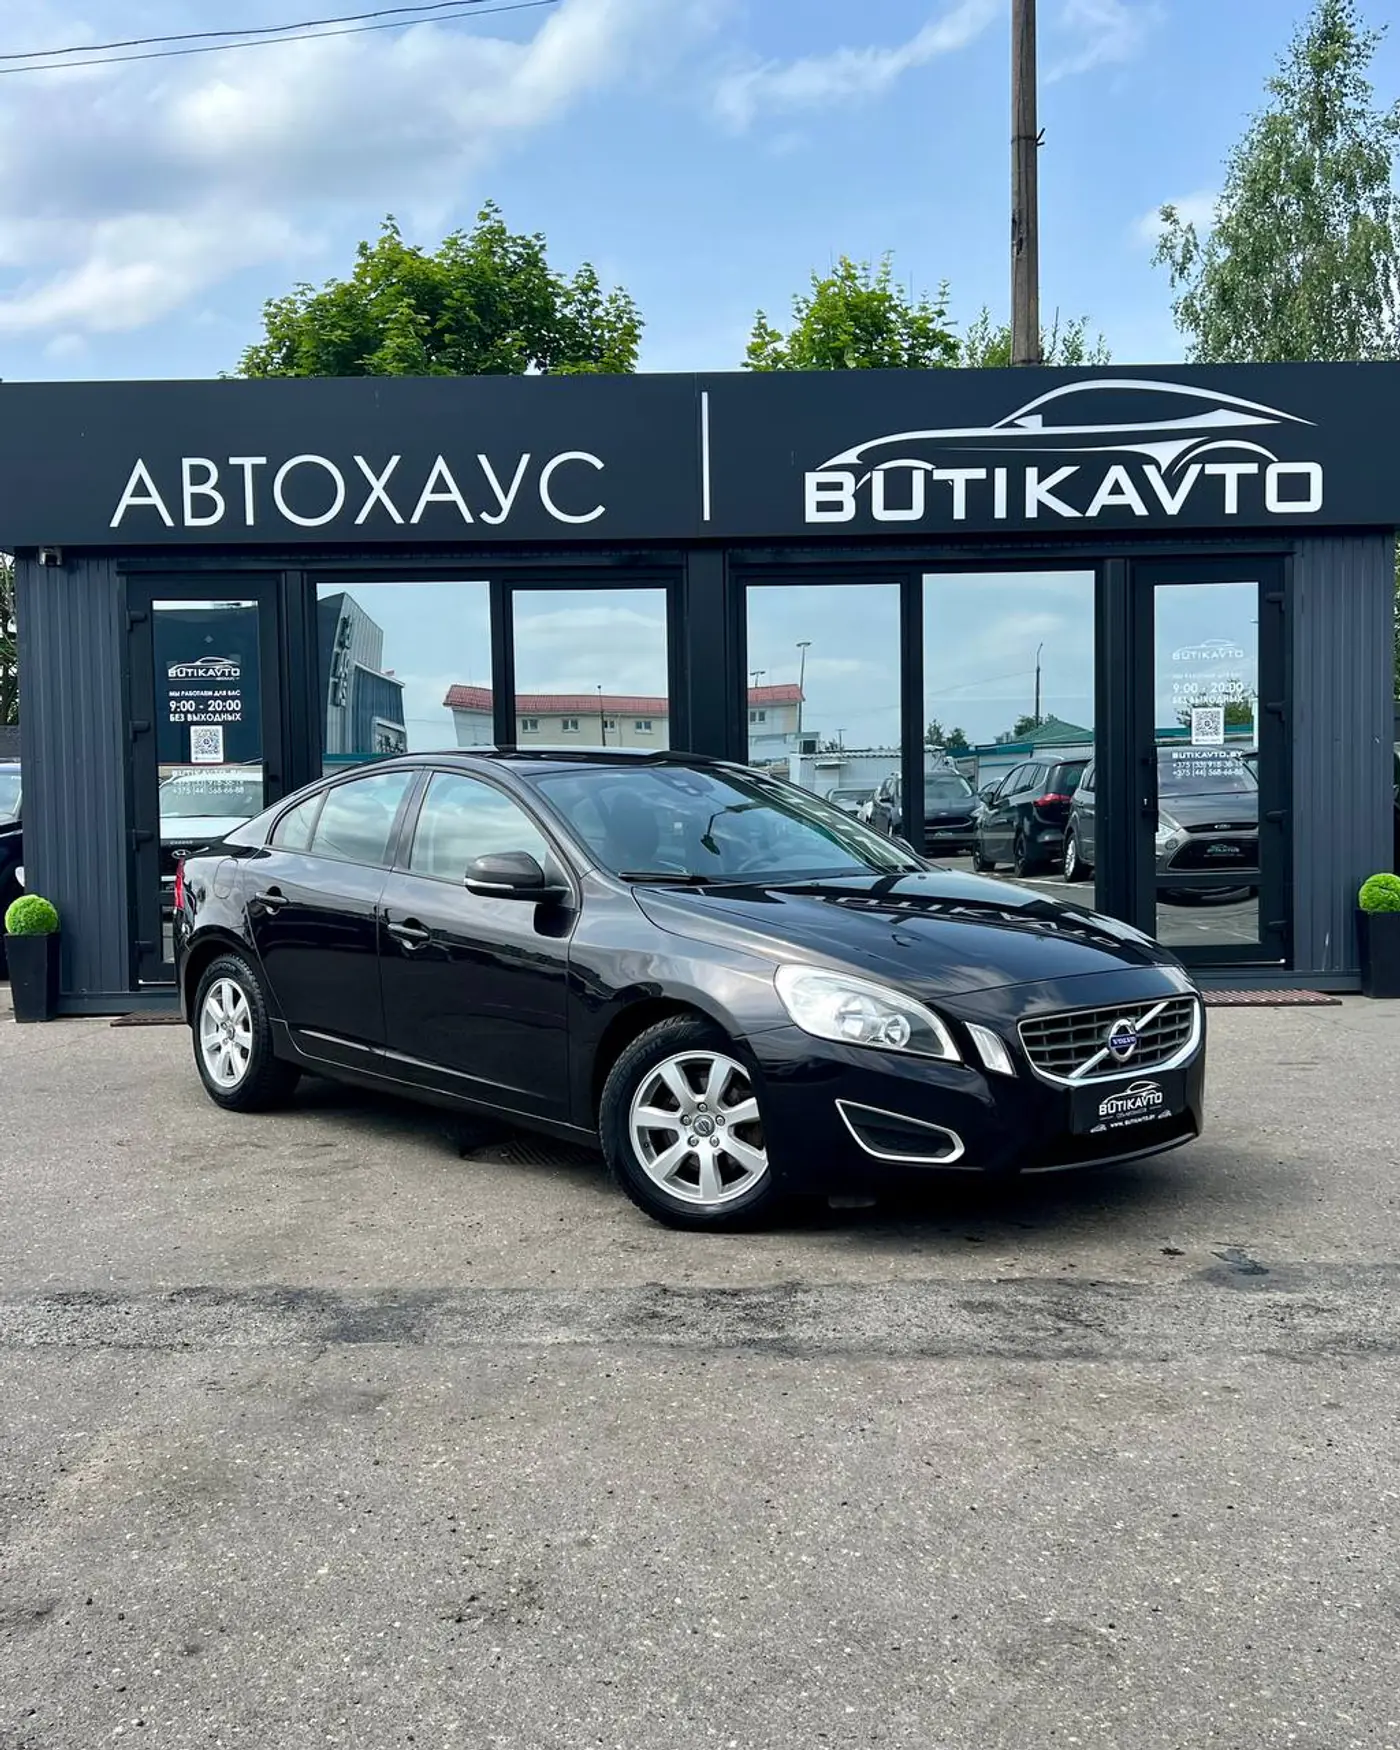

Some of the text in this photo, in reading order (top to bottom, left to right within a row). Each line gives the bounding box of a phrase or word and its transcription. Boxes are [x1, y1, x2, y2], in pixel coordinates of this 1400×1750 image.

[110, 451, 605, 527] АВТОХАУС
[805, 461, 1323, 523] BUTIKAVTO
[1172, 649, 1244, 660] BUTIKAVTO
[168, 668, 241, 677] BUTIKAVTO
[1172, 682, 1198, 693] 9:00
[1210, 682, 1244, 693] 20:00
[169, 700, 195, 712] 9:00
[208, 700, 241, 711] 20:00
[169, 712, 242, 722] БЕЗ ВЫХОДНЫХ
[1172, 751, 1243, 759] BUTIKAVTO.BY
[1112, 1036, 1136, 1045] VOLVO
[1099, 1092, 1162, 1115] BUTIKAVTO
